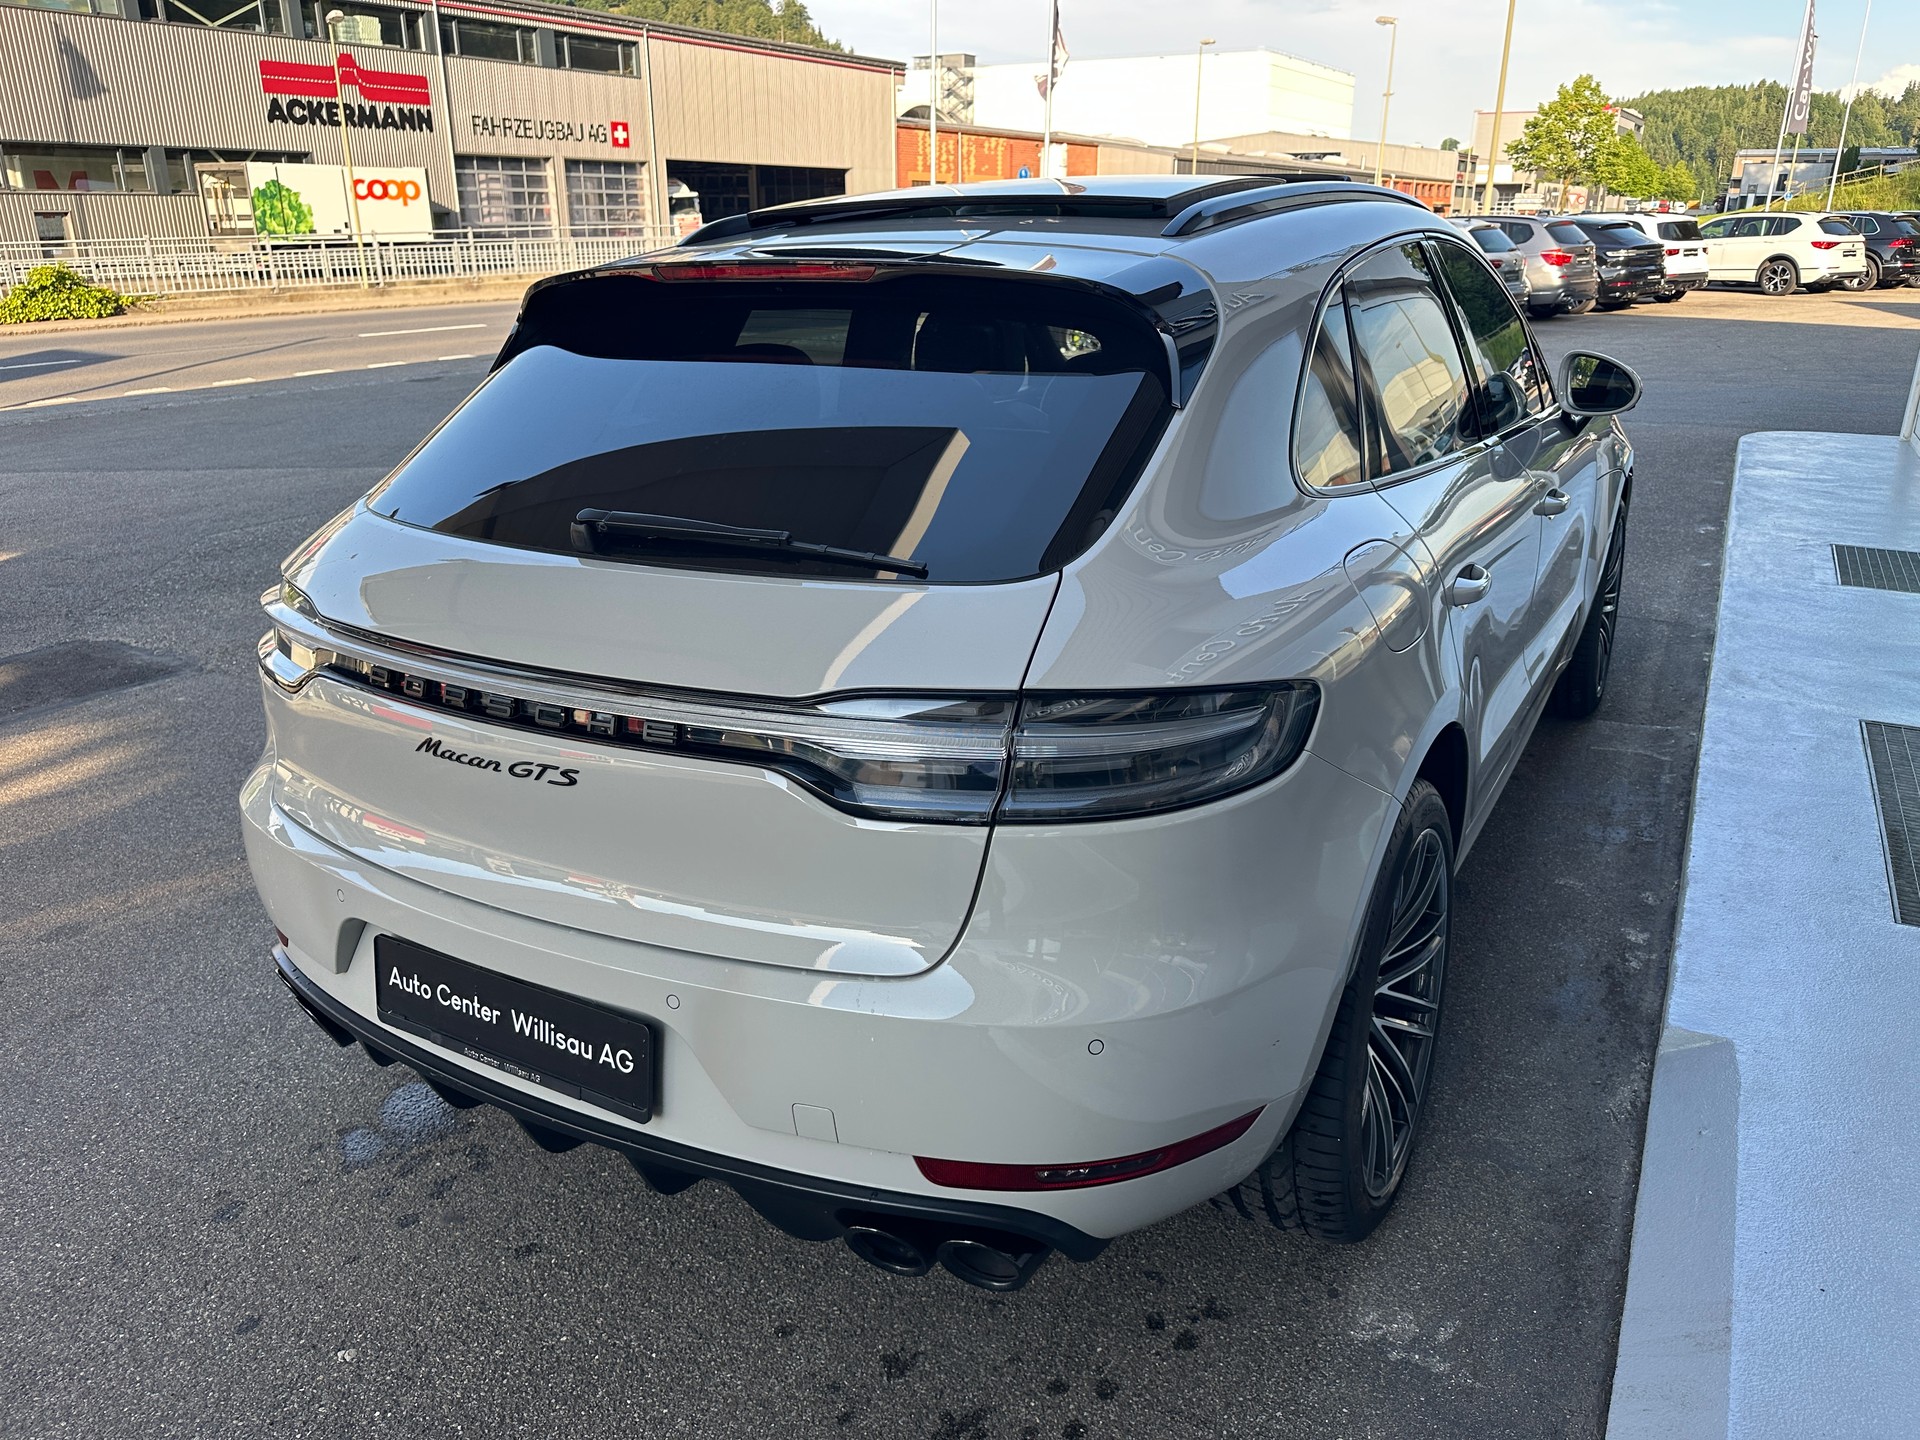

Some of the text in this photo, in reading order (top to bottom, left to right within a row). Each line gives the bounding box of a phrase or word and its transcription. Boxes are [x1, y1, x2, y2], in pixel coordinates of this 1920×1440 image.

[267, 97, 434, 133] ACKERMANN
[472, 115, 607, 144] FAHRZEUGBAU AG
[352, 178, 421, 207] coop
[369, 664, 678, 746] PORSCHE
[415, 737, 580, 787] Macan GTS
[389, 966, 635, 1075] Auto Center Willisau AG
